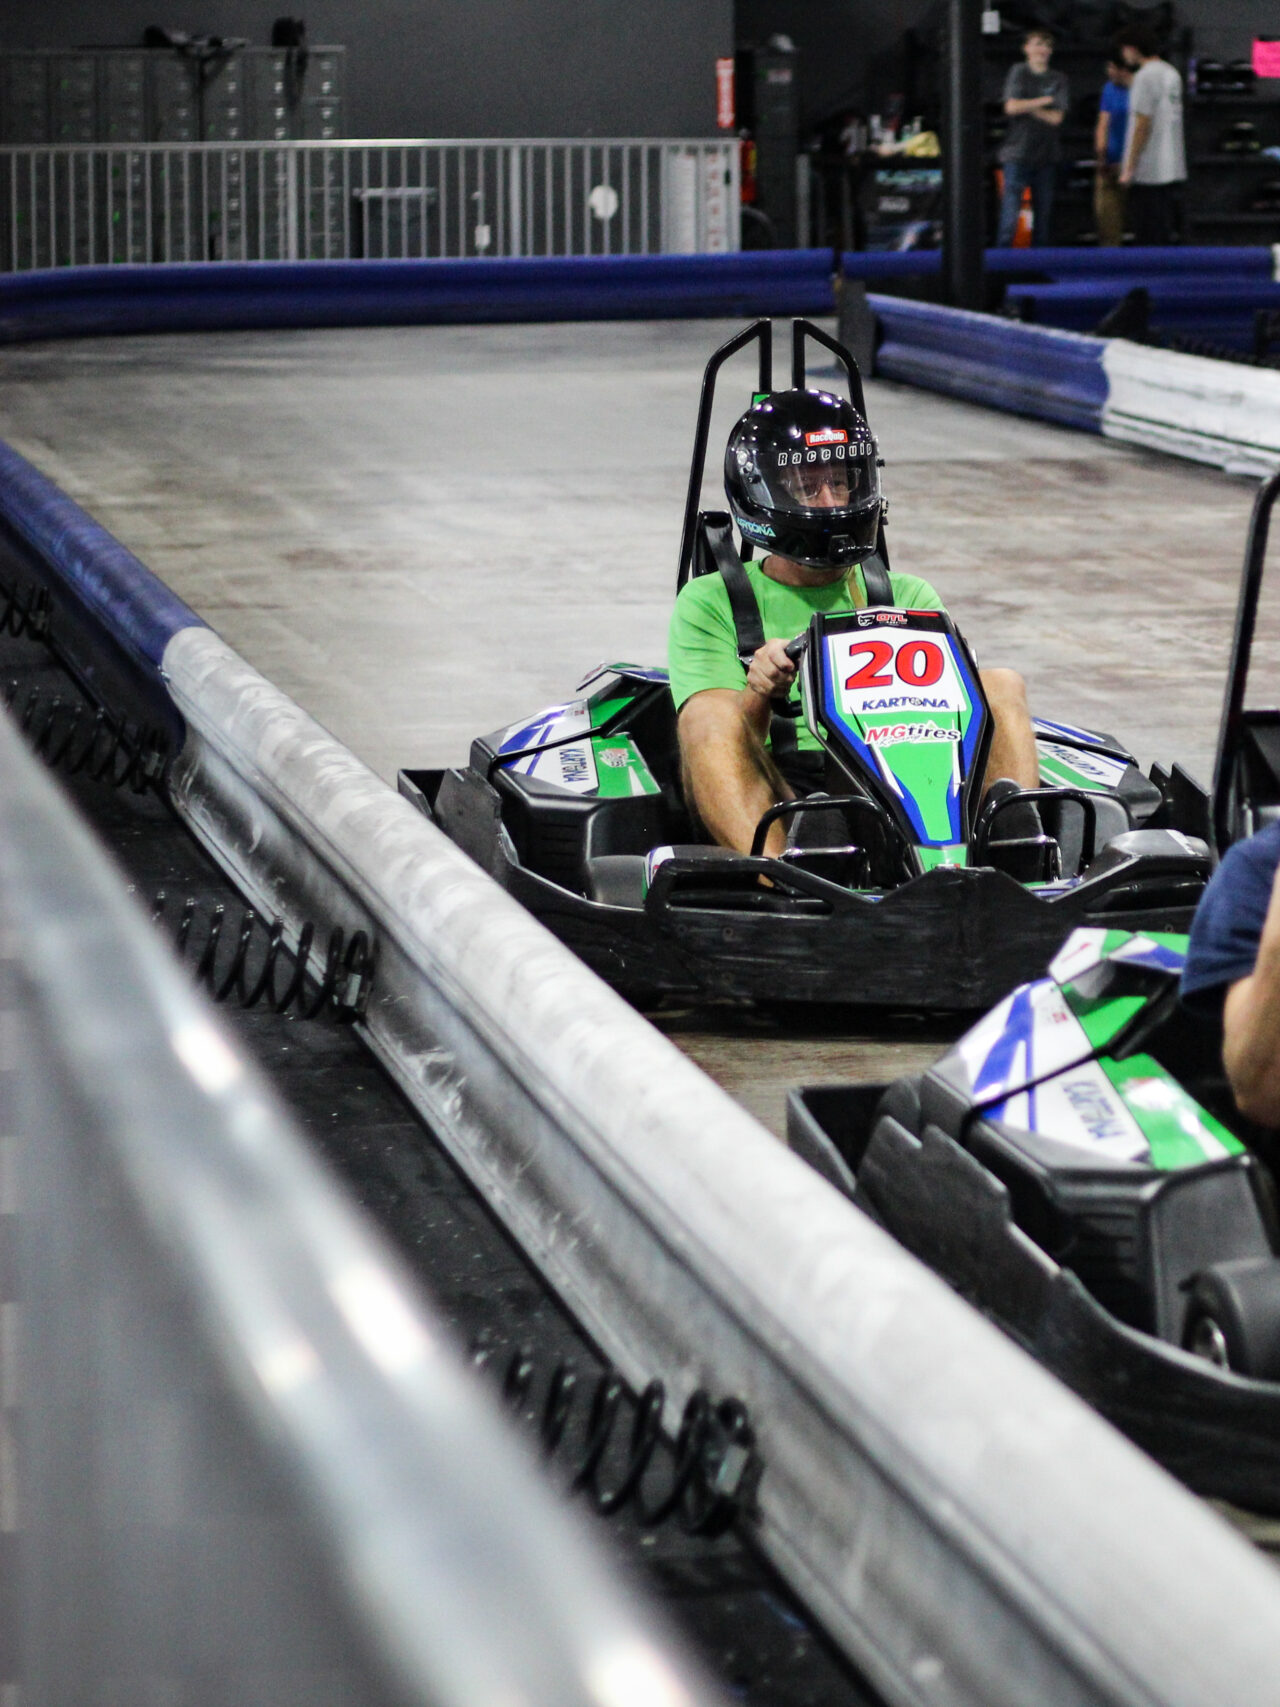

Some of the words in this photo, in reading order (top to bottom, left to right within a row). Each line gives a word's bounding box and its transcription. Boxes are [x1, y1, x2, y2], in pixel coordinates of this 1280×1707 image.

[845, 640, 945, 690] 20
[862, 696, 950, 711] KARTONA
[866, 725, 959, 742] MGtires
